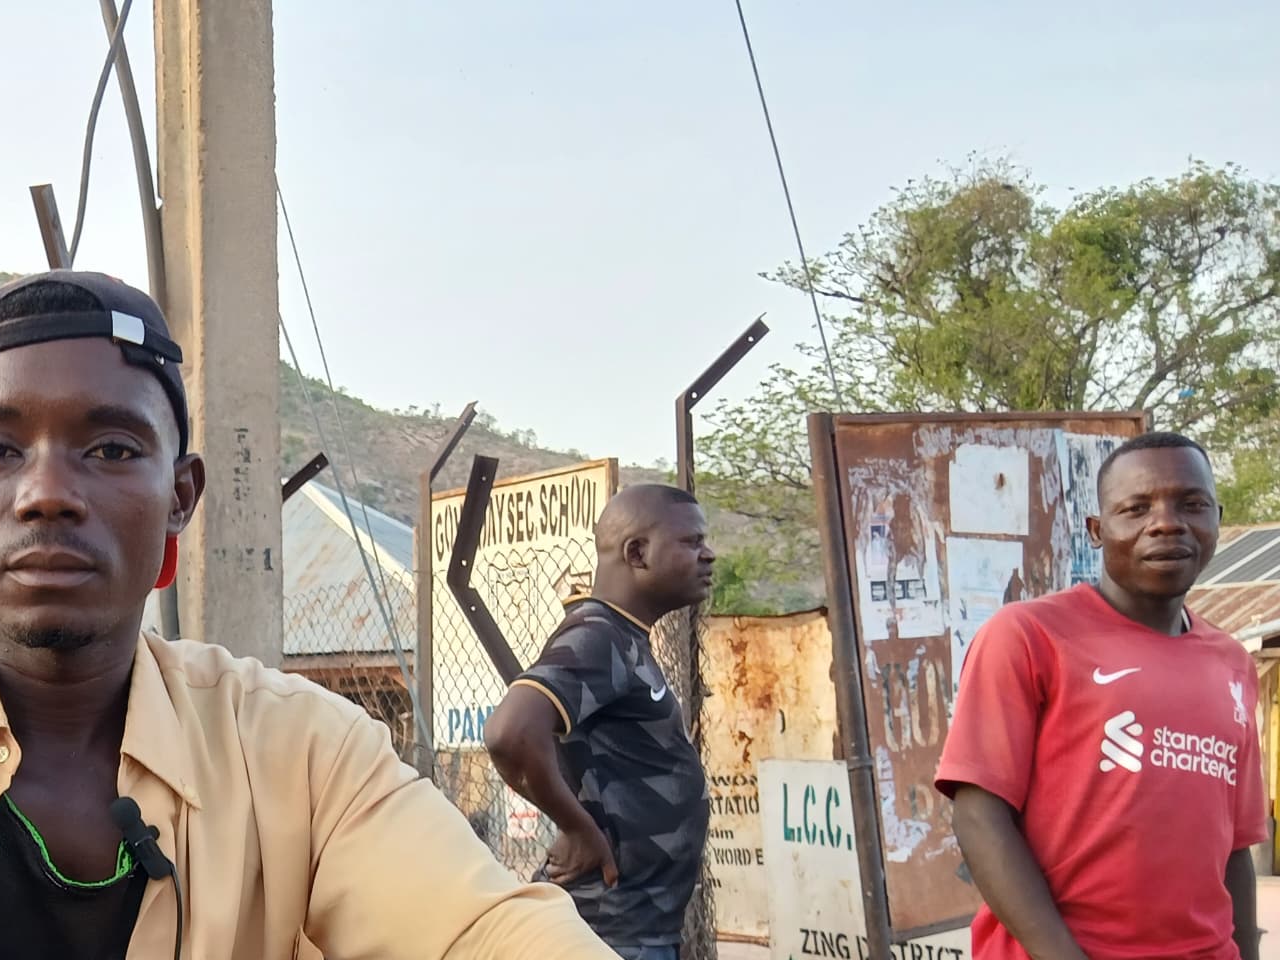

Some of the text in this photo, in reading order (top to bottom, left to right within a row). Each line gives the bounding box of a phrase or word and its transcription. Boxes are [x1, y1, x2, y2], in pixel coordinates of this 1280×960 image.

[435, 503, 464, 562] GOV
[539, 474, 598, 537] SCHOOL
[448, 705, 495, 743] PAN
[708, 795, 760, 815] RTATIO
[713, 848, 751, 866] WORD
[800, 928, 850, 960] ZING
